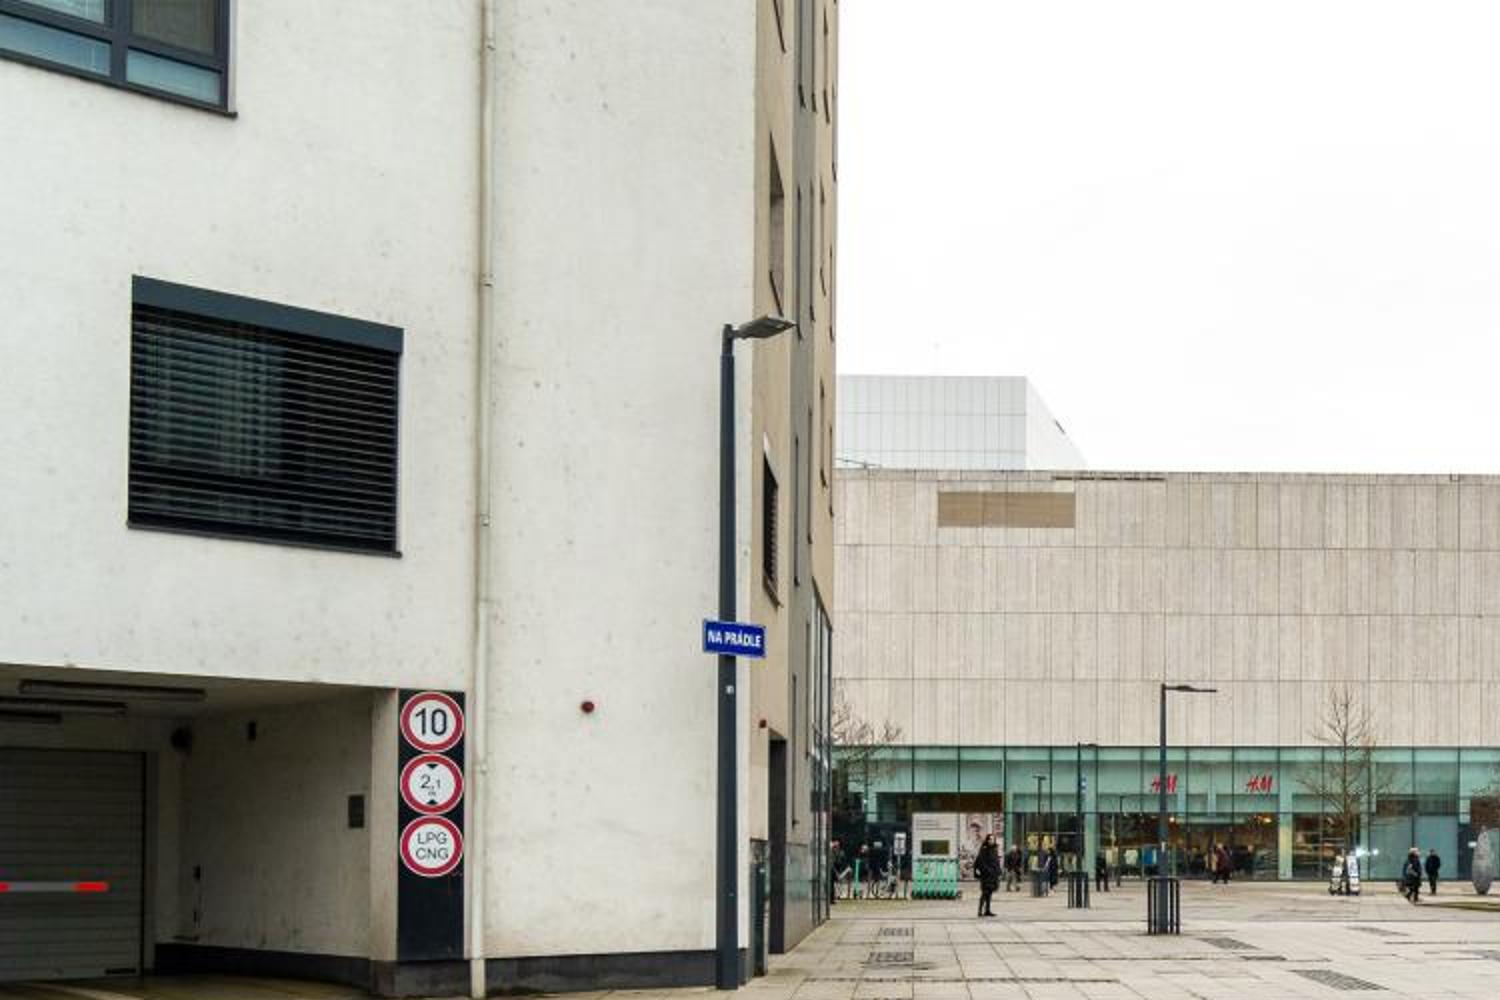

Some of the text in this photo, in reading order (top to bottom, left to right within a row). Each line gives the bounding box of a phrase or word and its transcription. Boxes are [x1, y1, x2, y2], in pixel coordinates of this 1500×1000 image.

[707, 629, 762, 648] NA PRÁDLE
[415, 708, 448, 736] 10
[1152, 775, 1178, 793] HM
[416, 832, 448, 845] LPG
[415, 847, 449, 861] CNG
